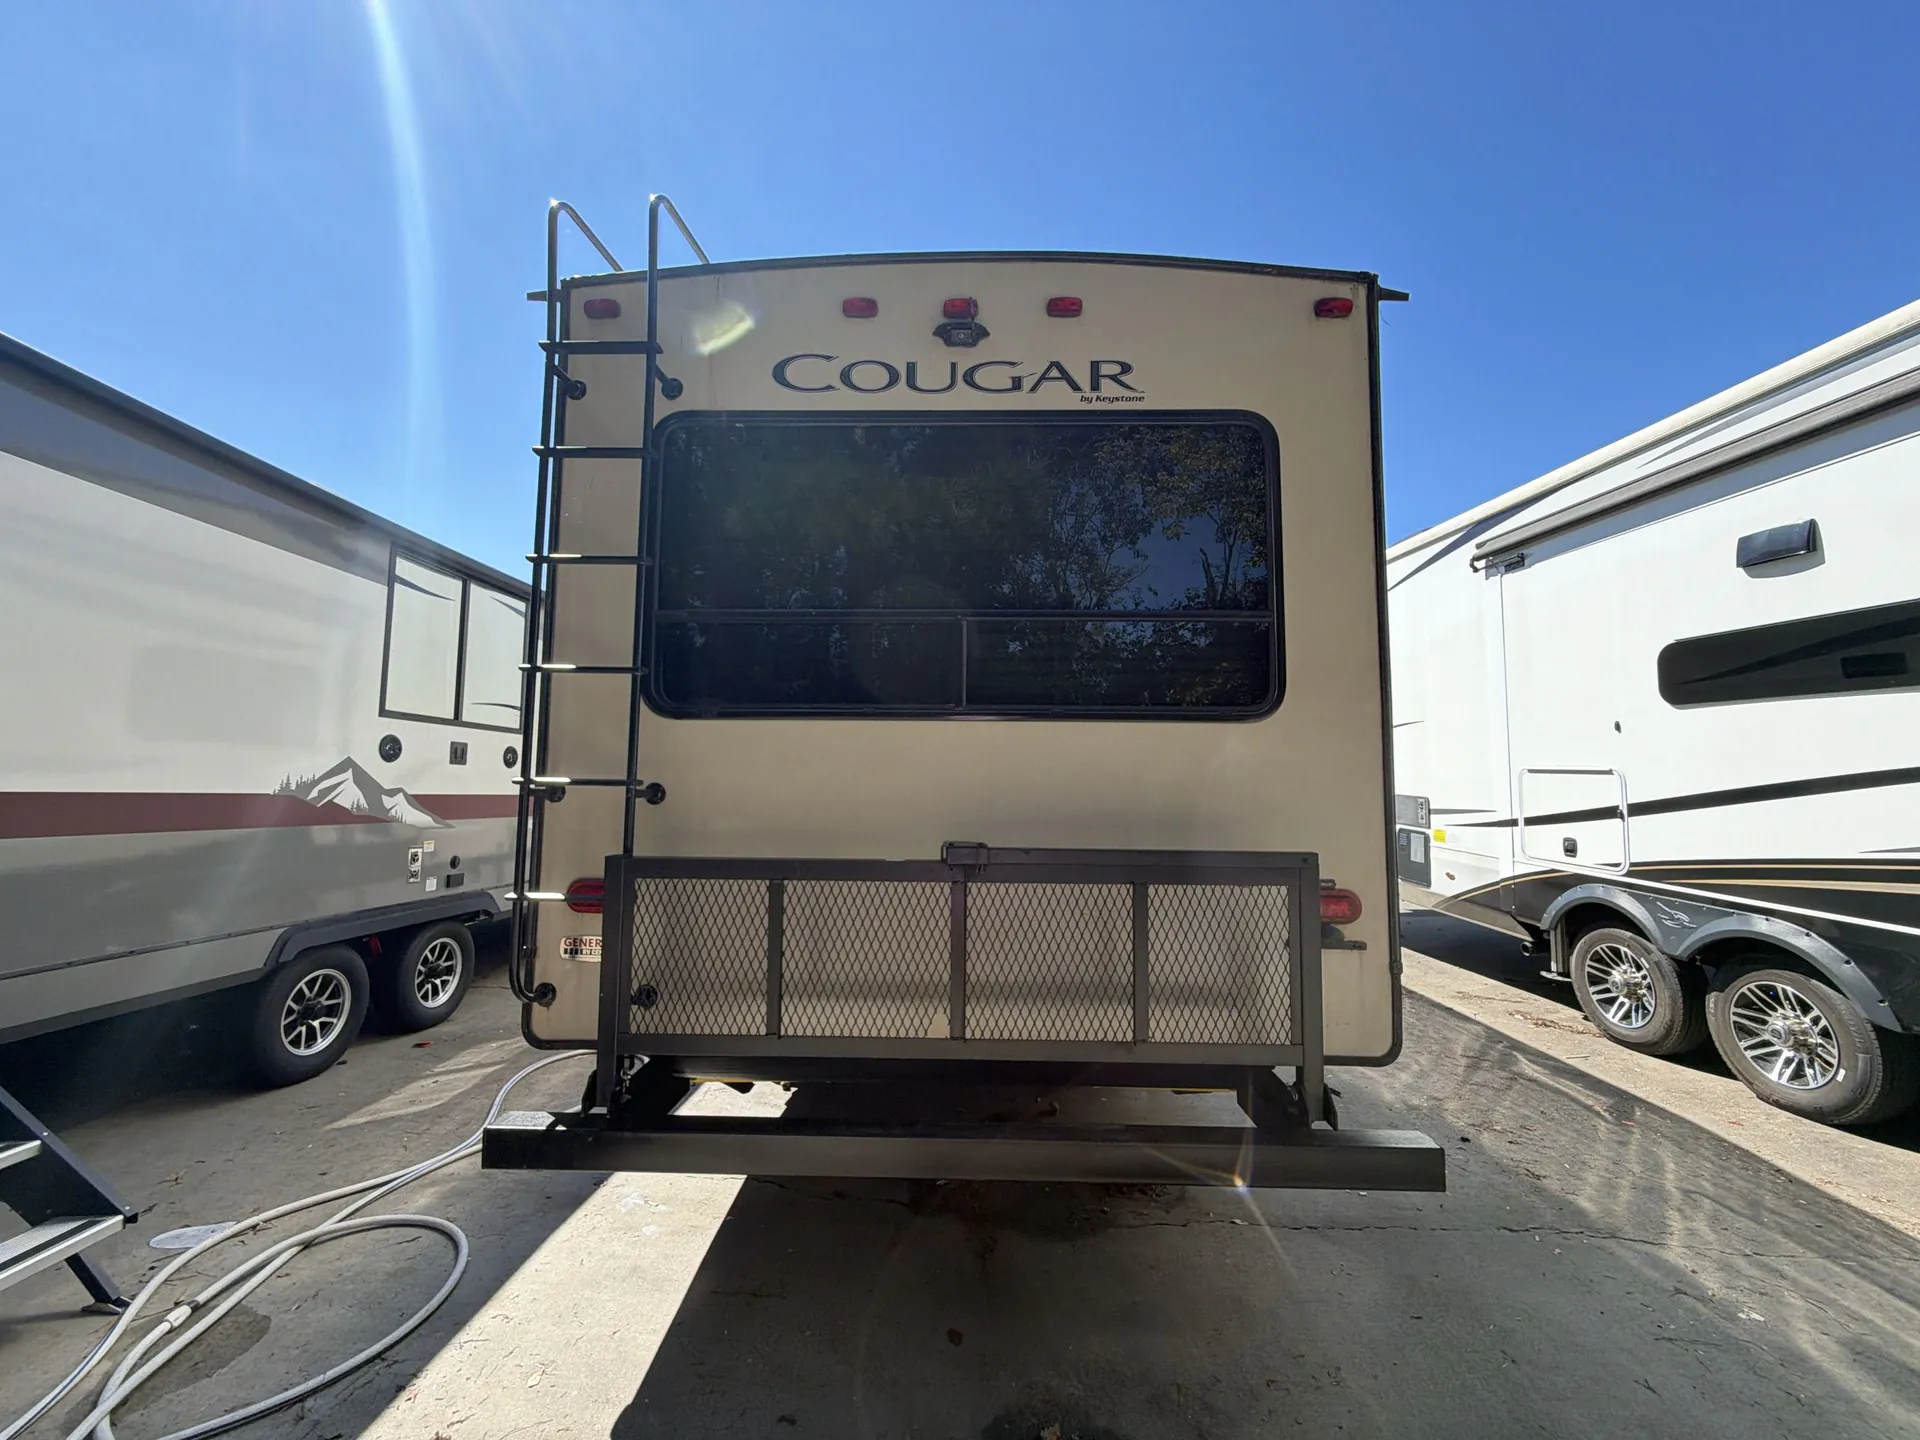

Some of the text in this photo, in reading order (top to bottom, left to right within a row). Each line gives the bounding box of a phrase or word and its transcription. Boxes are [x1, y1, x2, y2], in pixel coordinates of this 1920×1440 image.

[772, 353, 1146, 393] COUGAR
[1080, 394, 1145, 404] by Keystone
